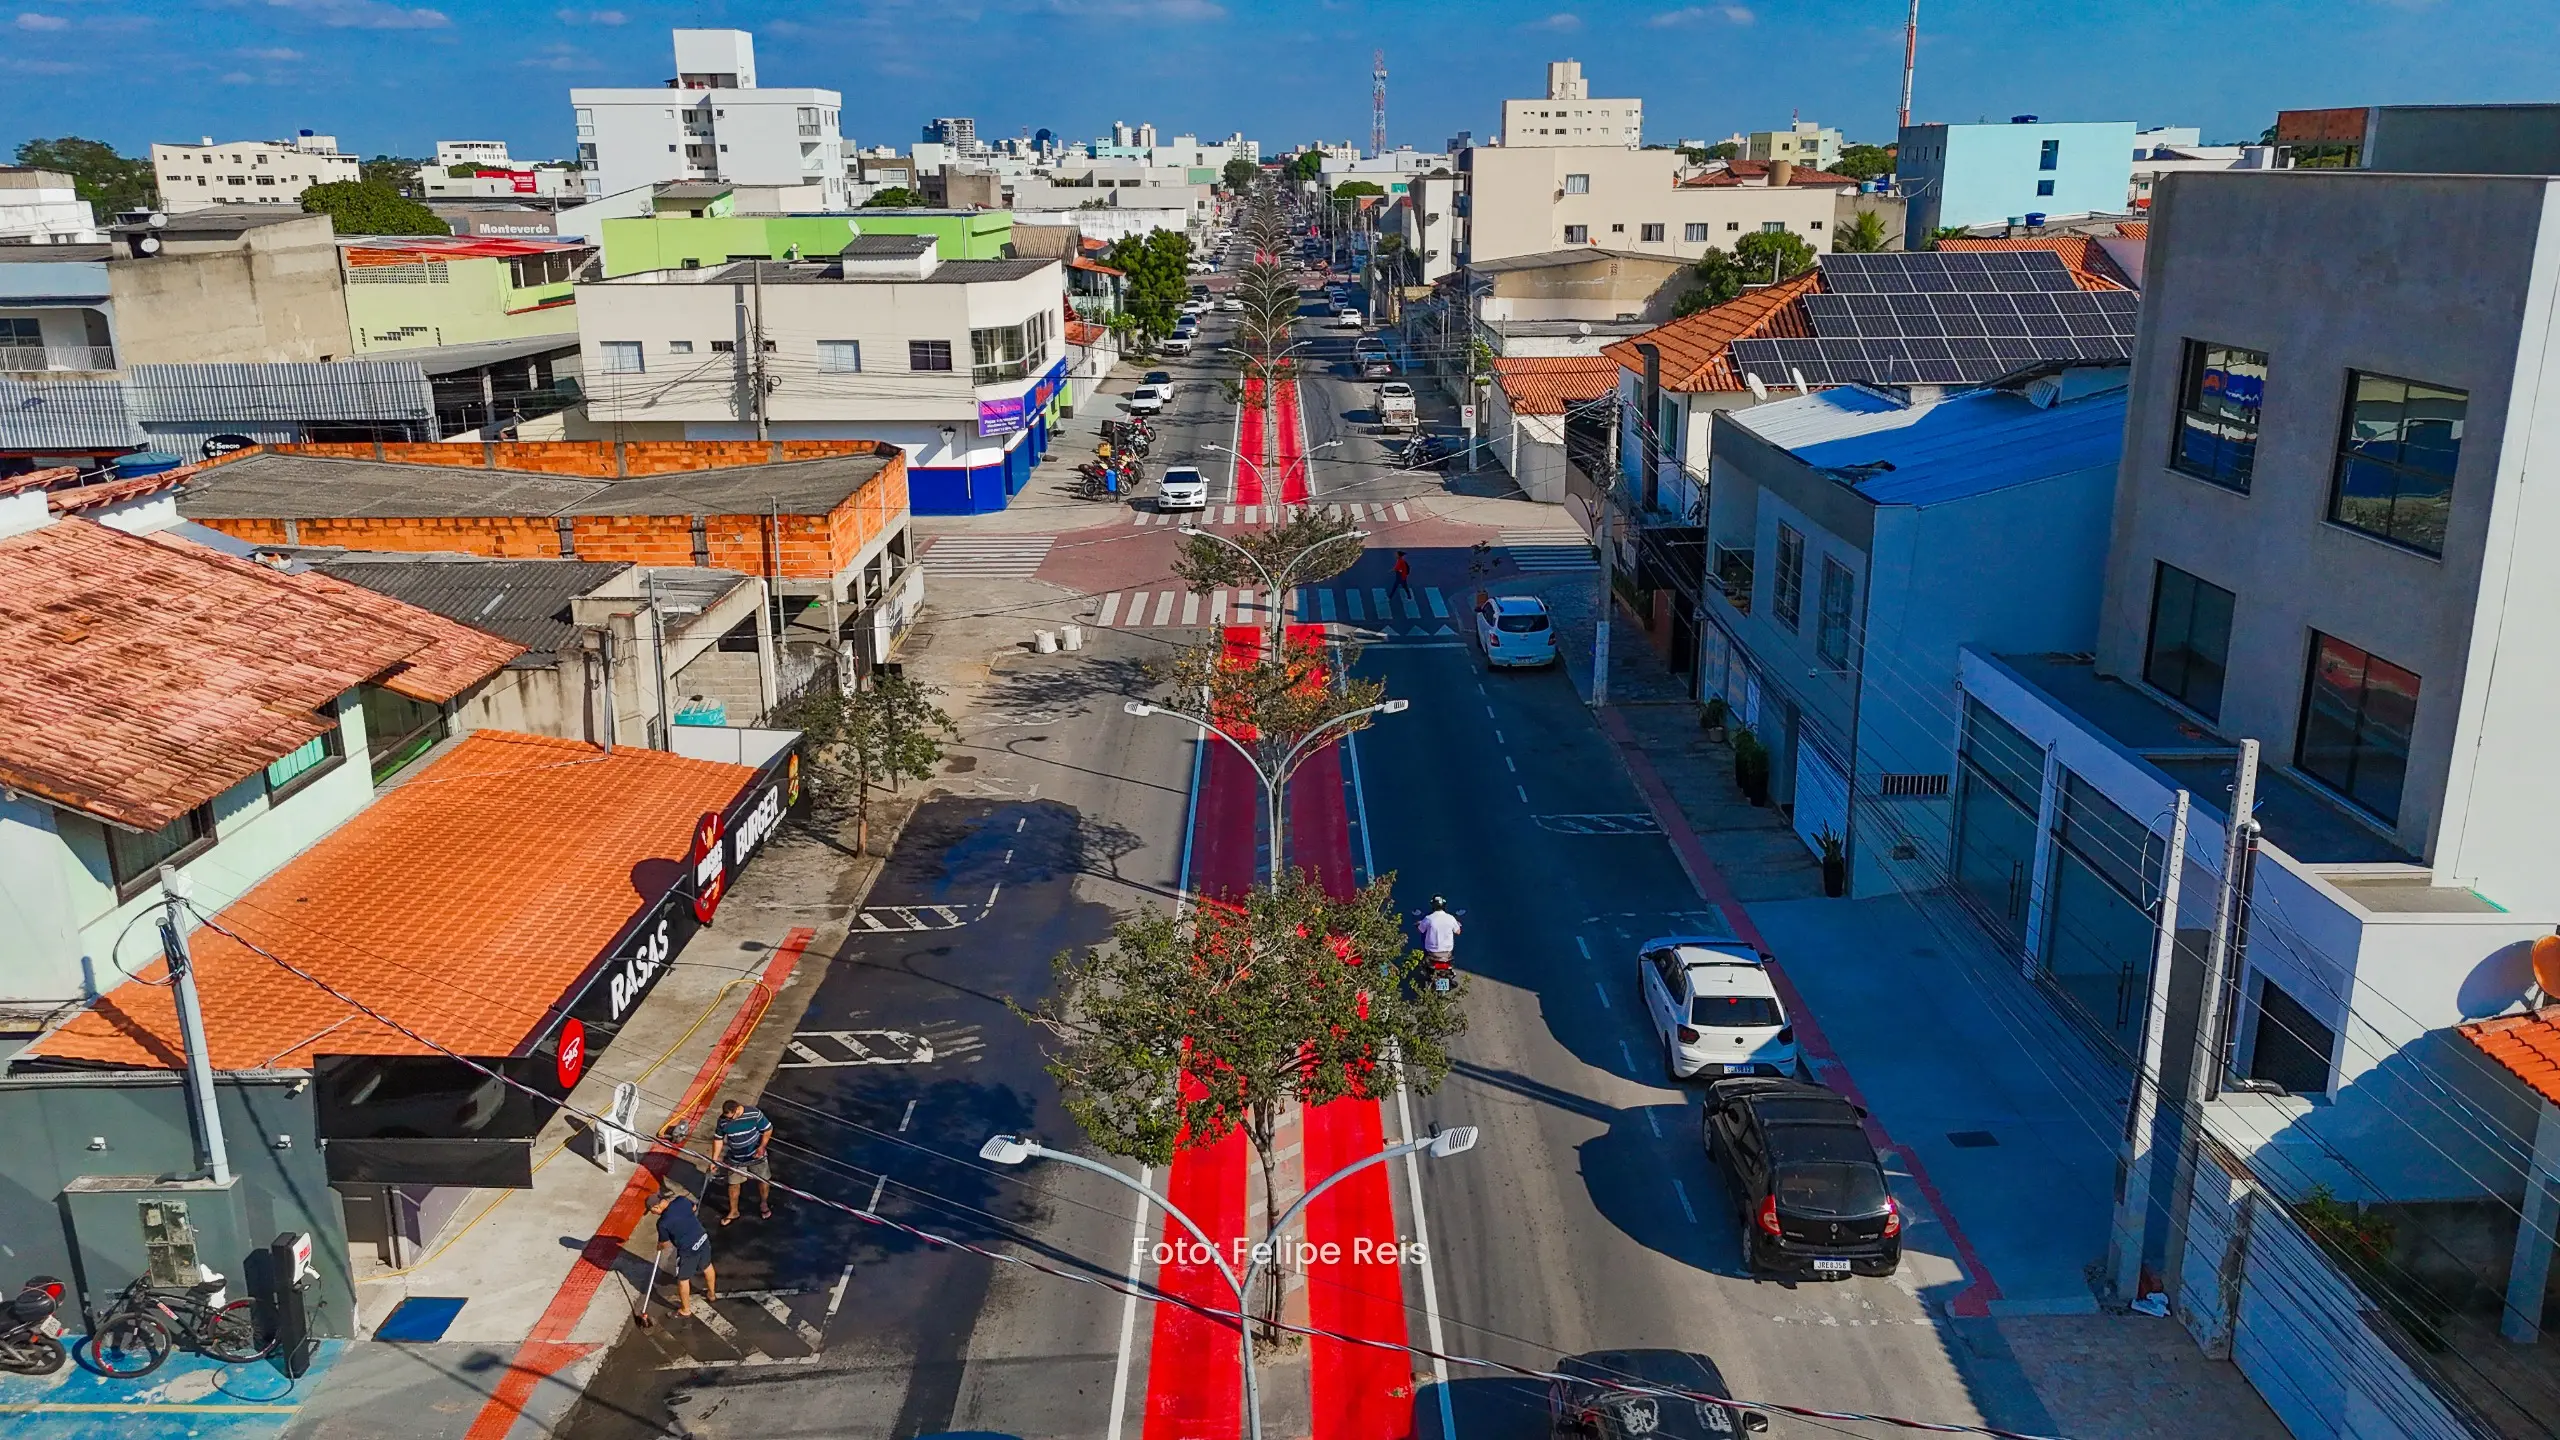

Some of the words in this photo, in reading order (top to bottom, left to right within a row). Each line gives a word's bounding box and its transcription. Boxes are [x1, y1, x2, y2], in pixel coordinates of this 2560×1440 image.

[480, 223, 550, 234] Monteverde
[736, 785, 778, 865] BURGER
[611, 919, 669, 1020] RASAS
